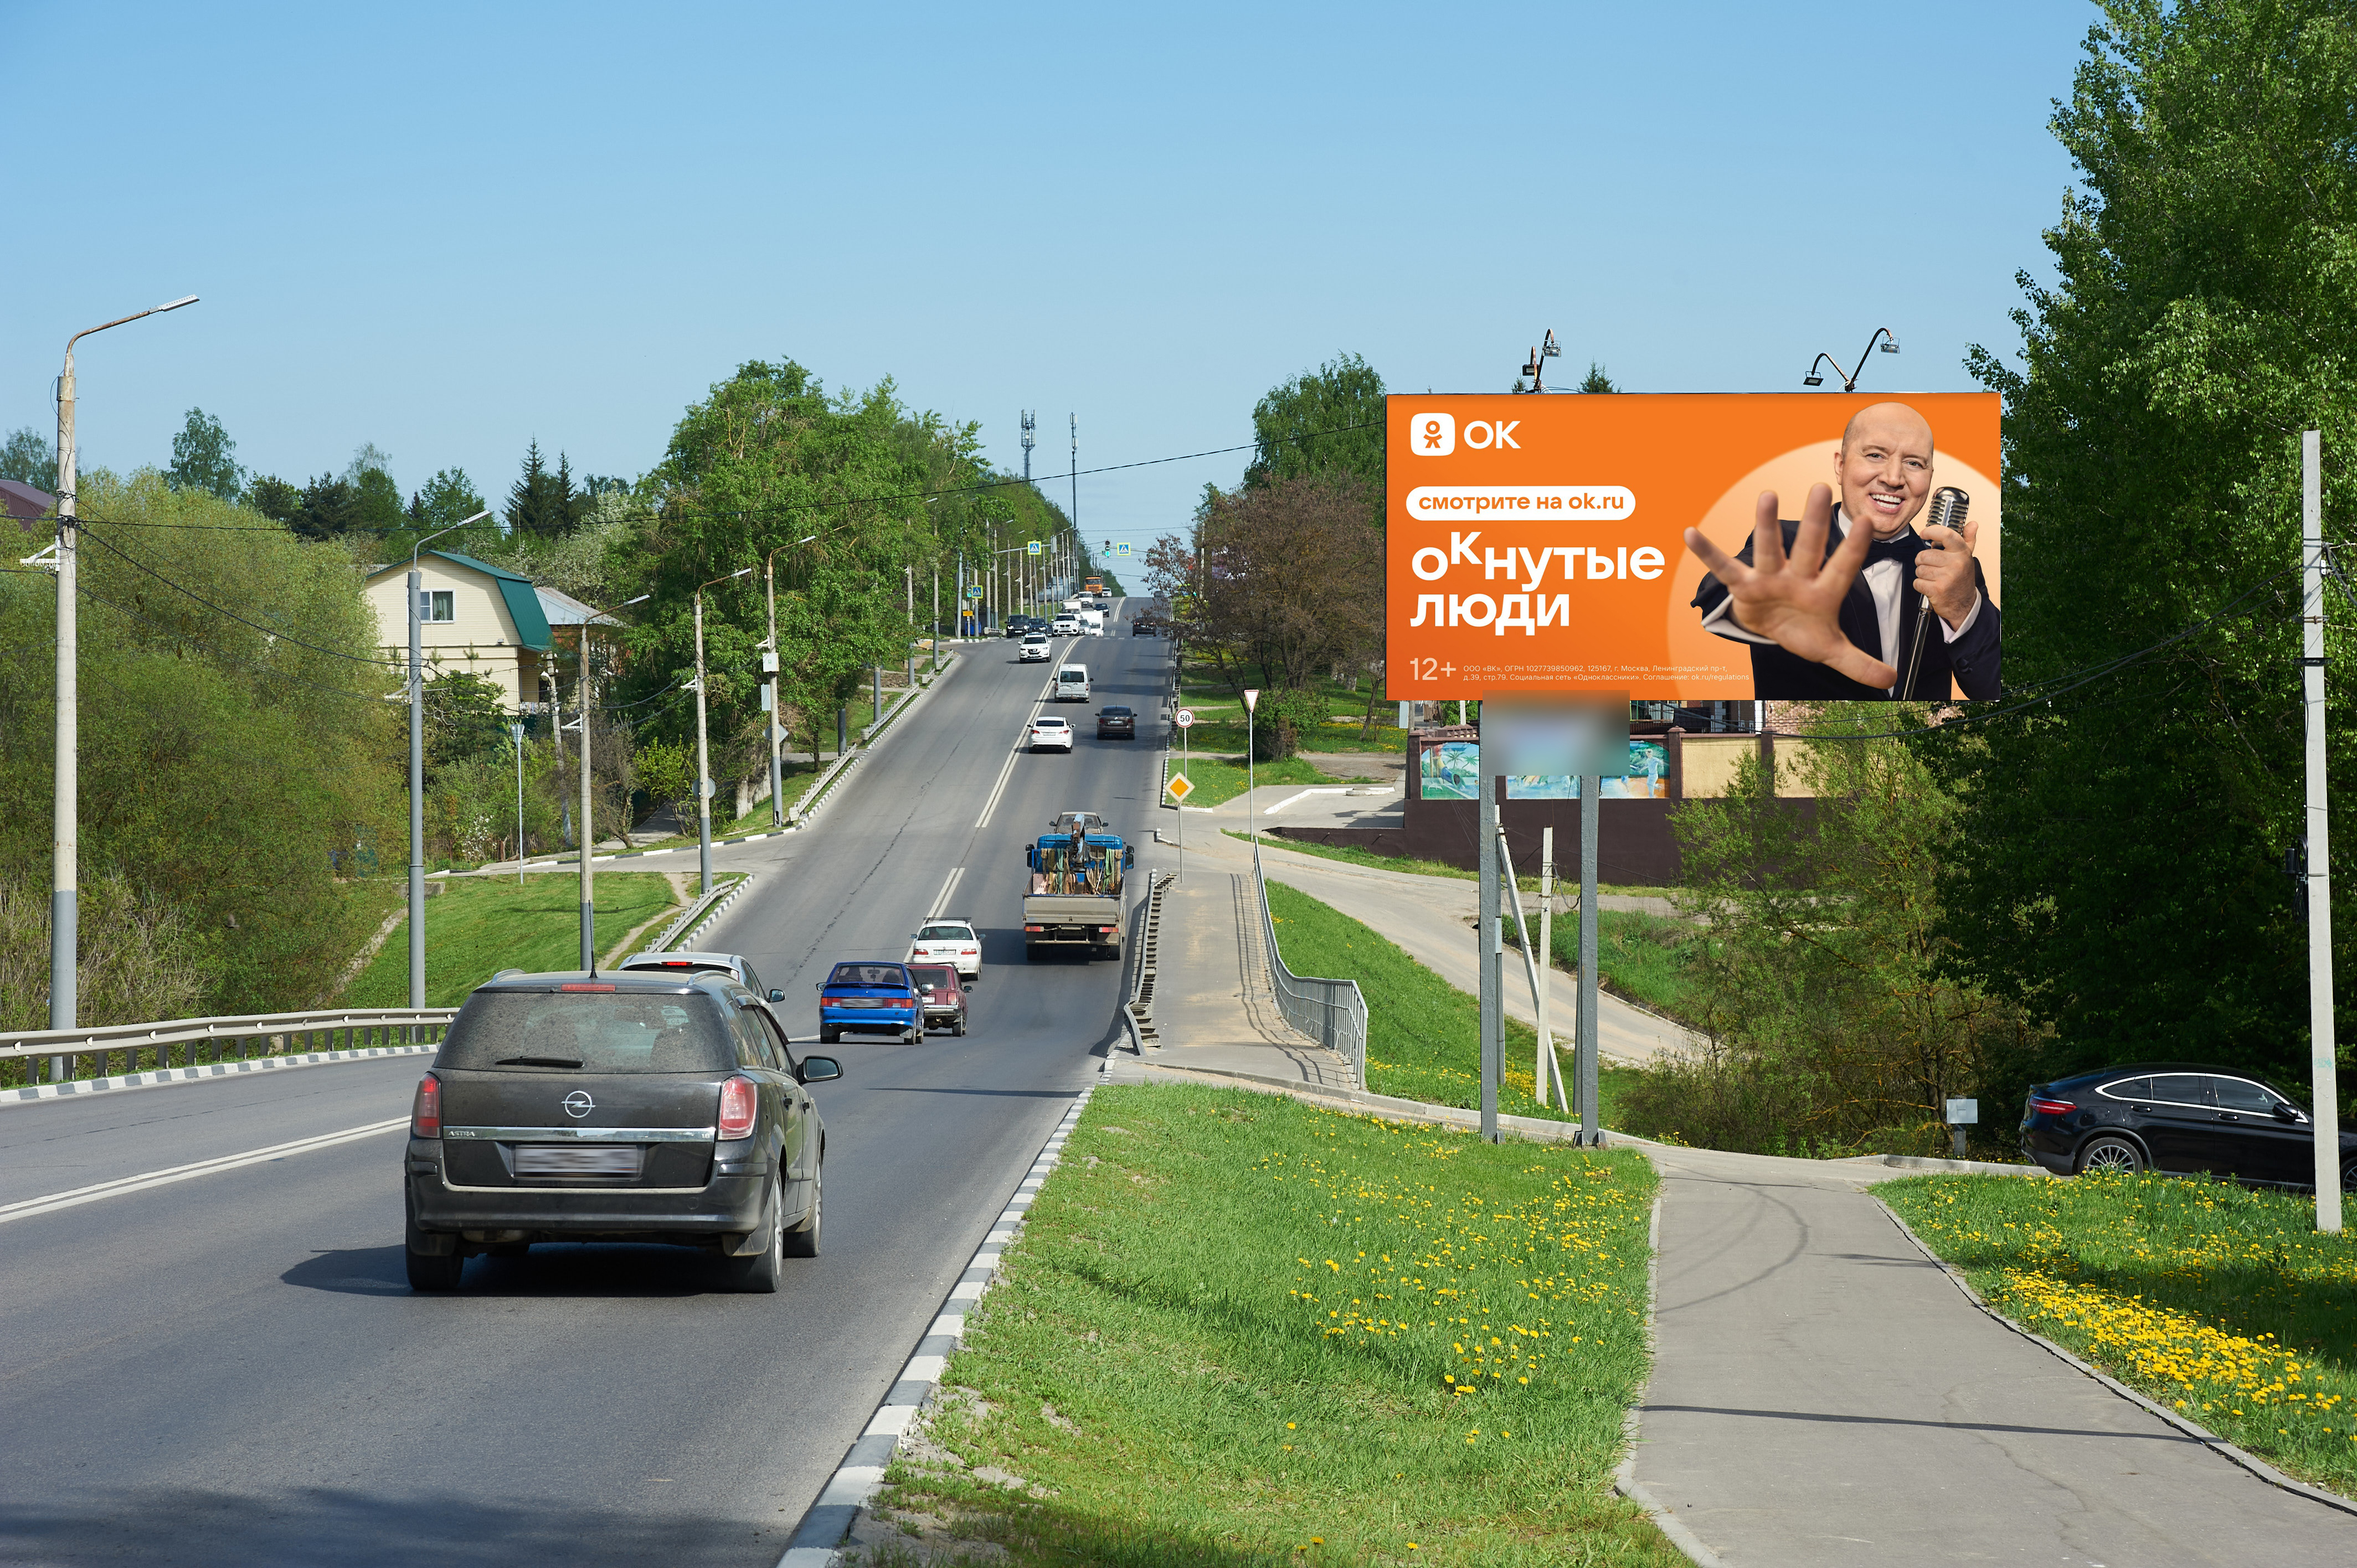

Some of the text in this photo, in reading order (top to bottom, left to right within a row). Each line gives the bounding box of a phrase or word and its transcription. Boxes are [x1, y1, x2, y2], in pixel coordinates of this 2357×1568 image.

[1464, 420, 1521, 449] ОК
[1418, 493, 1624, 514] смотрите на ok.ru
[1412, 532, 1665, 592] оКнутые
[1410, 593, 1569, 636] люди
[1410, 657, 1457, 680] 12+
[1652, 665, 1708, 673] Ленинградский
[1691, 674, 1749, 682] ok.ru/regulations
